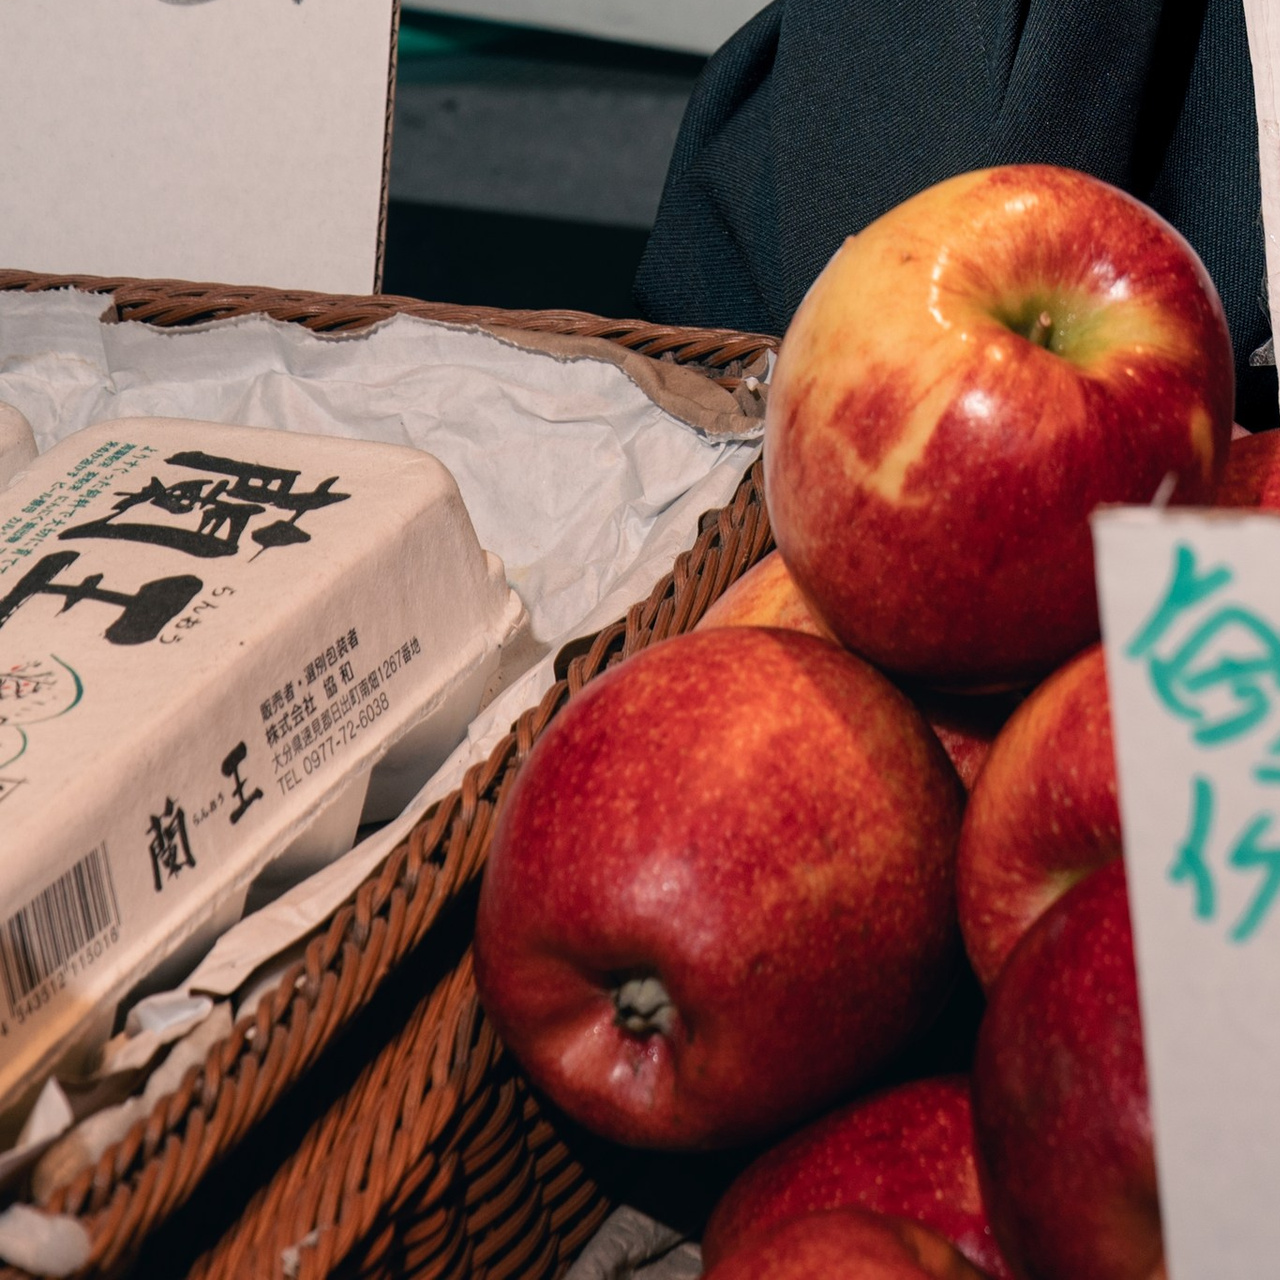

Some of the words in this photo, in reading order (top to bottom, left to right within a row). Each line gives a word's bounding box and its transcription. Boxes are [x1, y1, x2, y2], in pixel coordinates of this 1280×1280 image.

[265, 693, 317, 748] 株式会社
[276, 767, 302, 796] TEL
[303, 691, 390, 776] 0977-72-6038
